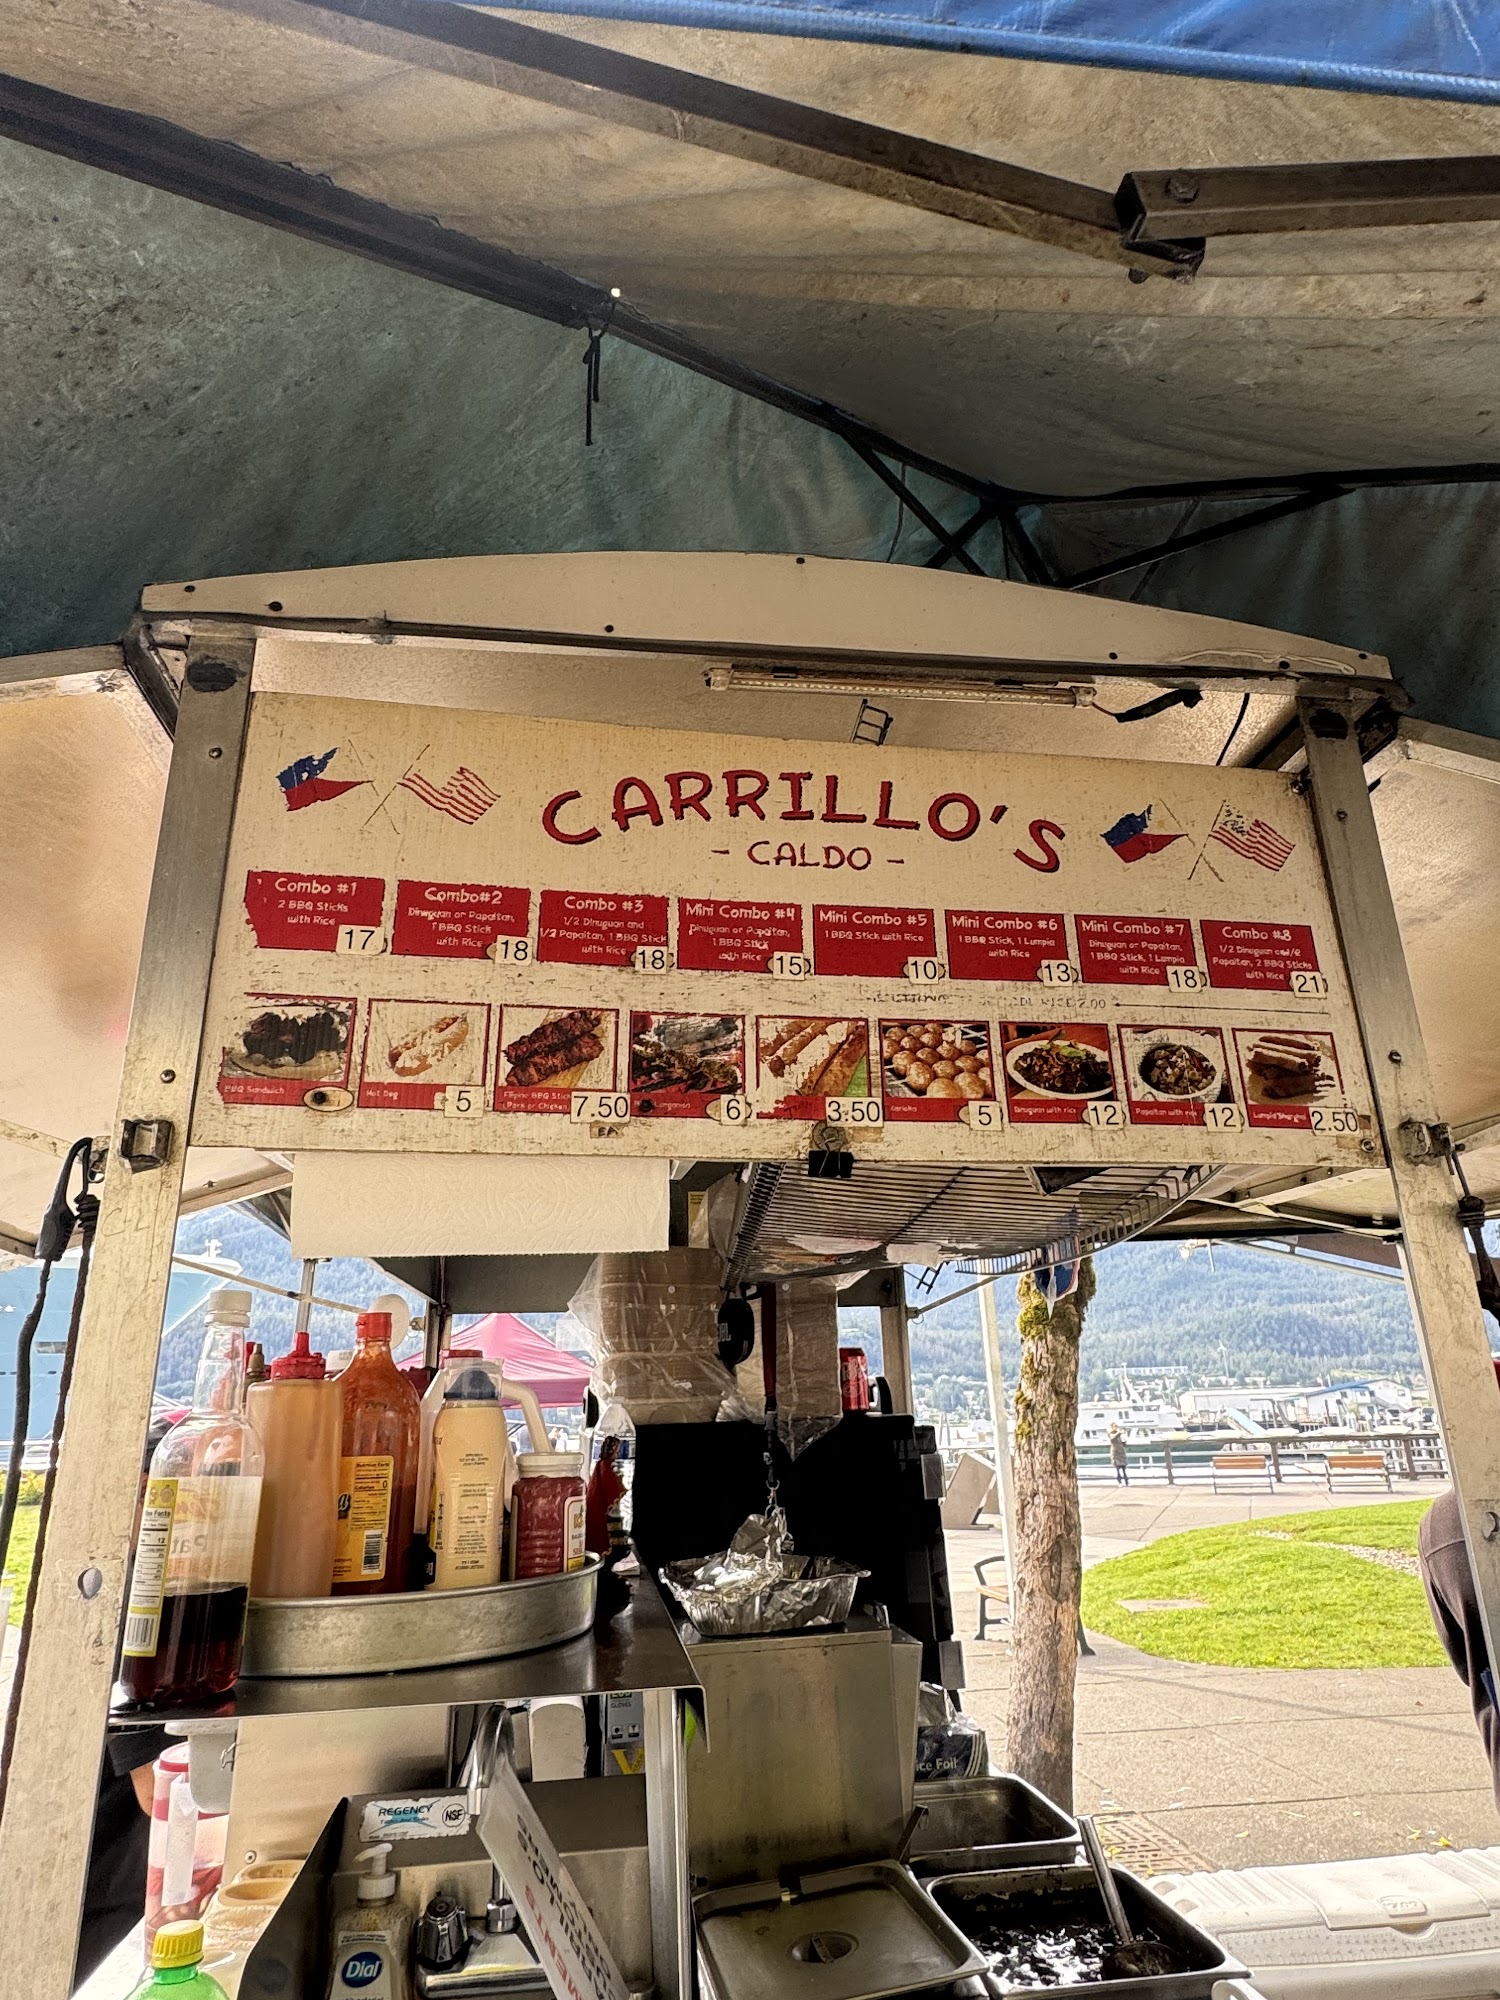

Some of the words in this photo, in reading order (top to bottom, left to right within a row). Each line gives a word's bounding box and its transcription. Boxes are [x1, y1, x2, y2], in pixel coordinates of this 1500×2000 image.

[542, 769, 1066, 874] CARRILLO'S
[746, 840, 872, 871] CALDO
[275, 877, 331, 894] Combo
[337, 882, 357, 896] #1
[278, 900, 286, 909] 2
[289, 900, 313, 911] BBQ
[317, 902, 348, 912] Sticks
[564, 896, 617, 912] Combo
[622, 899, 644, 913] #3
[686, 902, 714, 917] Mini
[719, 905, 770, 920] Combo
[775, 907, 796, 921] #4
[287, 915, 311, 924] with
[313, 916, 336, 925] Rice
[563, 916, 579, 926] 1/2
[627, 920, 645, 929] and
[819, 909, 848, 923] Mini
[852, 911, 902, 926] Combo
[907, 913, 928, 927] #5
[952, 915, 979, 928] Mini
[984, 917, 1033, 930] Combo
[1037, 918, 1058, 931] #6
[438, 923, 462, 932] BBQ
[465, 925, 492, 934] Stick
[831, 930, 853, 941] BBQ
[855, 931, 880, 941] Stick
[882, 932, 901, 941] with
[904, 933, 924, 942] Rice
[1081, 920, 1109, 932] Mini
[1113, 921, 1160, 935] Combo
[1164, 923, 1185, 936] #7
[1222, 926, 1268, 940] Combo
[1272, 929, 1291, 941] #8
[345, 929, 375, 949] 17
[436, 937, 459, 947] with
[462, 938, 483, 948] Rice
[616, 934, 638, 942] BBQ
[641, 934, 667, 943] Stick
[719, 938, 742, 947] BBQ
[744, 939, 769, 950] Stick
[964, 936, 986, 945] BBQ
[501, 939, 528, 961] 18
[581, 945, 603, 954] with
[605, 945, 626, 955] Rice
[719, 952, 739, 961] with
[742, 952, 762, 961] Rice
[988, 949, 1008, 957] with
[1010, 949, 1030, 958] Rice
[1097, 952, 1118, 961] BBQ
[1219, 945, 1234, 954] 1/2
[638, 949, 664, 970] 18
[776, 955, 802, 976] 15
[1256, 959, 1261, 967] 2
[1264, 960, 1284, 969] BBQ
[1287, 961, 1312, 970] Sticks
[911, 960, 937, 980] 10
[1043, 963, 1070, 983] 13
[1119, 966, 1139, 974] with
[1141, 966, 1160, 975] Rice
[1245, 970, 1264, 979] with
[1266, 971, 1284, 980] Rice
[1171, 970, 1197, 989] 18
[1295, 974, 1319, 993] 21
[456, 1090, 471, 1112] 5
[532, 1092, 549, 1100] BBQ
[573, 1095, 629, 1118] 7.50
[727, 1098, 740, 1120] 6
[827, 1100, 880, 1122] 3.50
[1046, 1106, 1061, 1114] with
[978, 1105, 992, 1126] 5
[1090, 1104, 1119, 1126] 12
[1208, 1106, 1237, 1128] 12
[1311, 1110, 1358, 1131] 2.50
[936, 1757, 958, 1771] Foil
[378, 1804, 434, 1817] REGENCY
[445, 1808, 464, 1822] NSF
[346, 1960, 381, 1979] Dial
